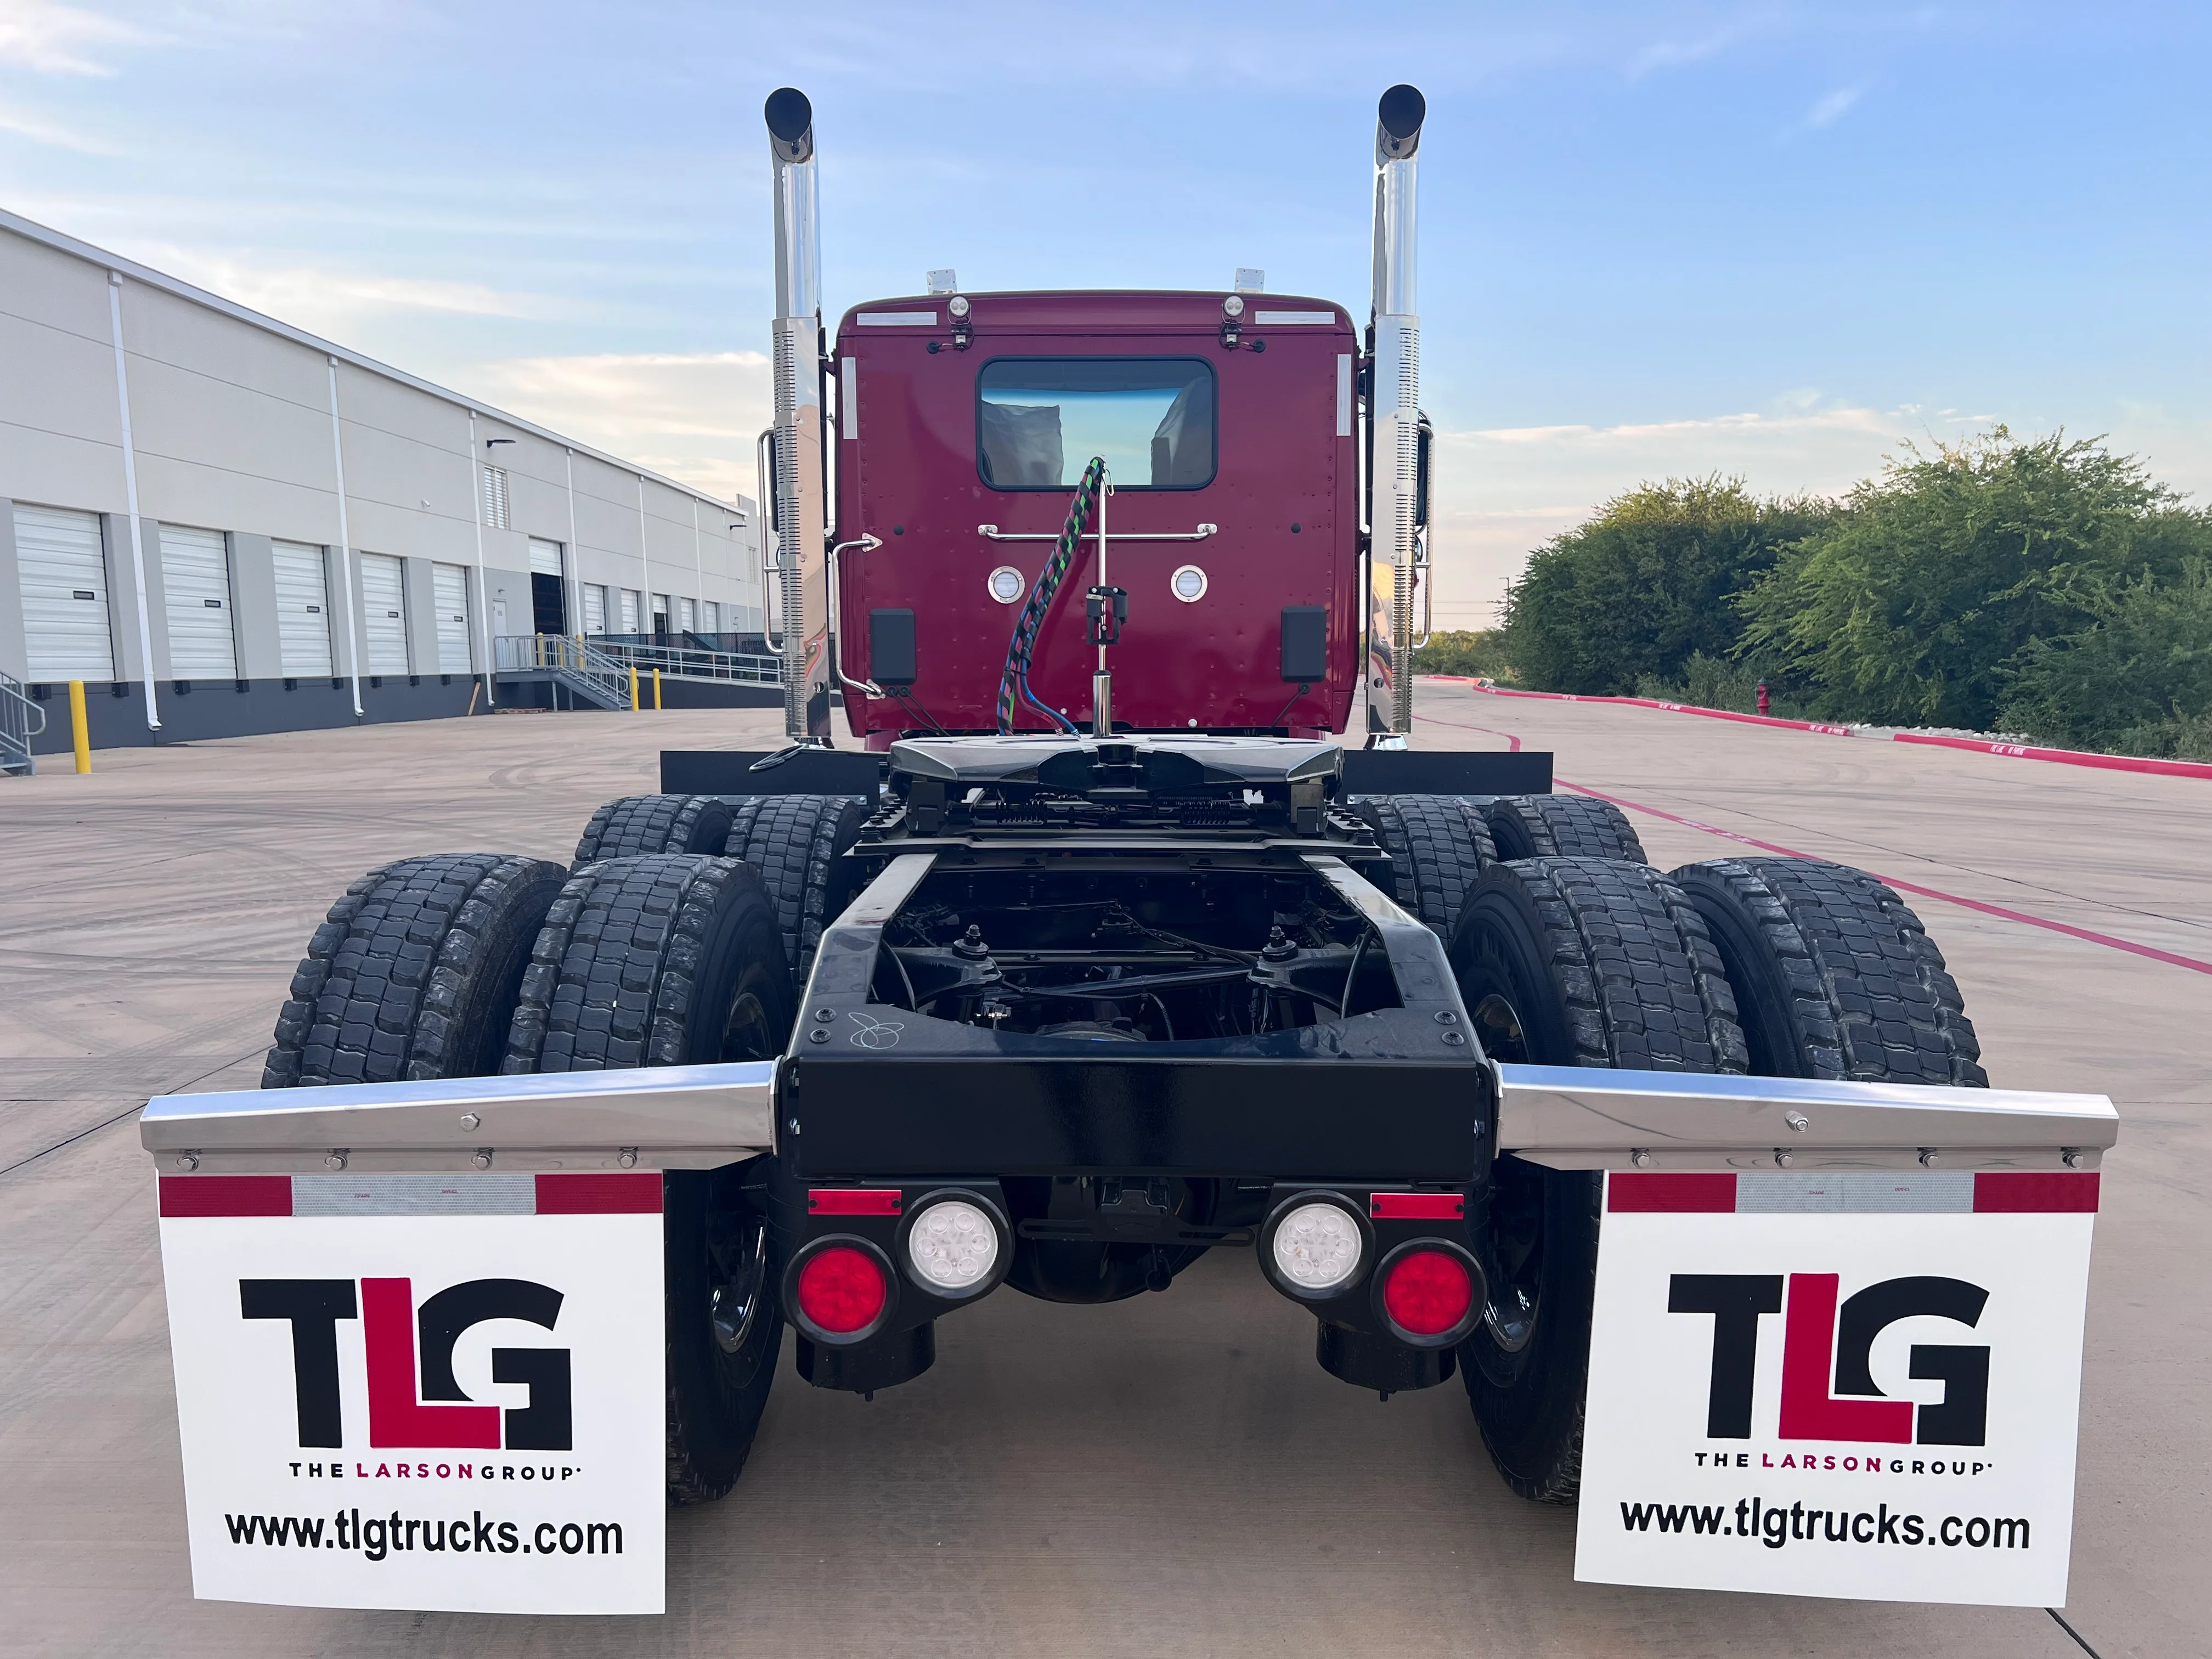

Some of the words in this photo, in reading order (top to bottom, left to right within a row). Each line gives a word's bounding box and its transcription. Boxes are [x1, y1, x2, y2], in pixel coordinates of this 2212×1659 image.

[239, 1278, 572, 1451] TLG
[1668, 1273, 1990, 1446] TLG
[289, 1463, 343, 1477] THE
[1695, 1453, 1748, 1467] THE
[225, 1509, 622, 1561] www.tlgtrucks.com
[1620, 1497, 2029, 1548] www.tlgtrucks.com
